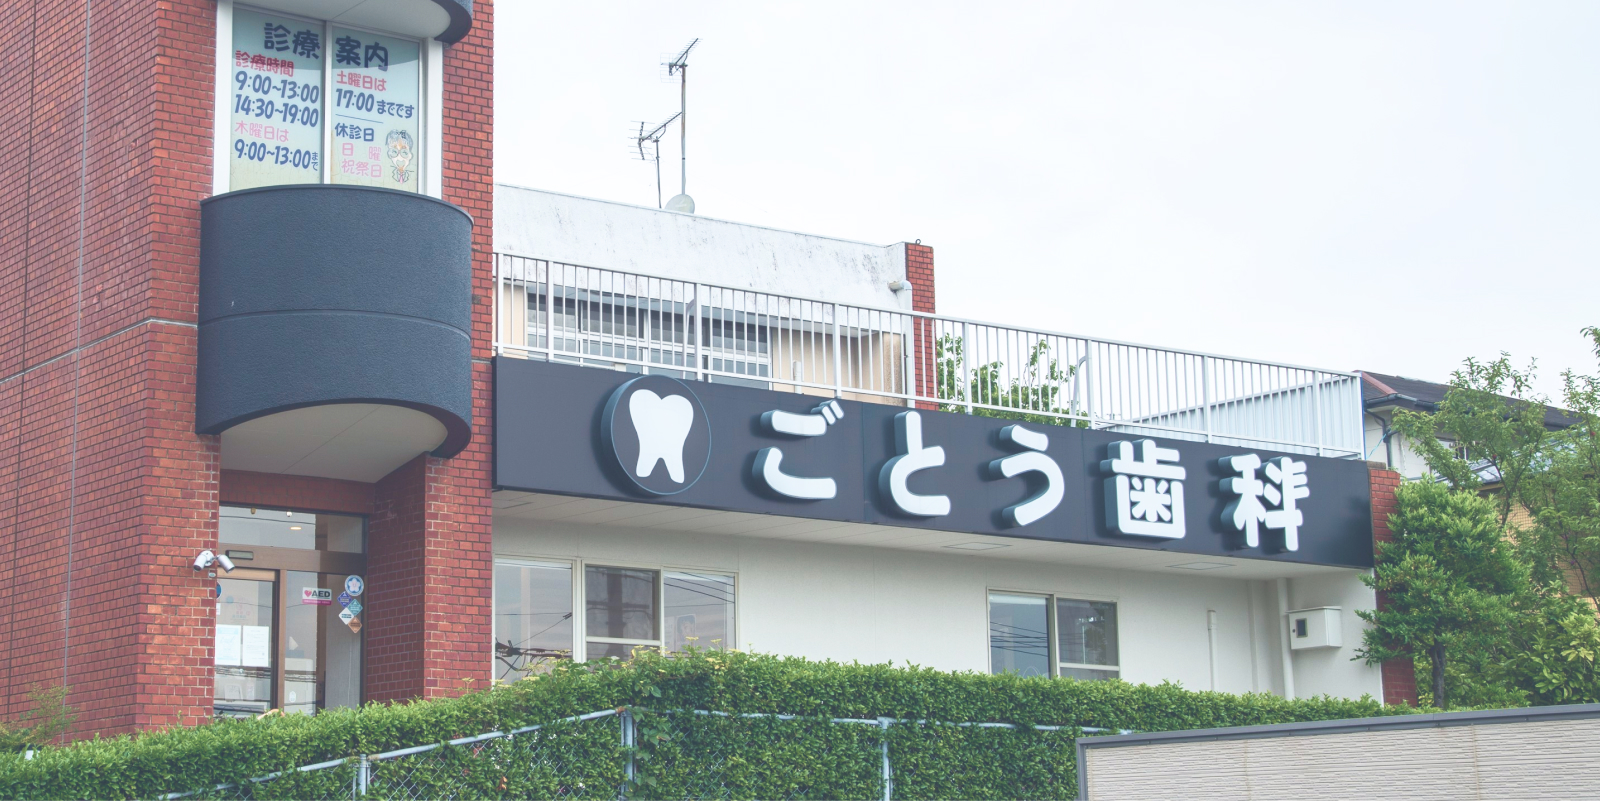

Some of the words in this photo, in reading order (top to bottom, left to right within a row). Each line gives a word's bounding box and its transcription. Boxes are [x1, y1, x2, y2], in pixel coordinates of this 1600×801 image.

[264, 22, 320, 60] 診療
[334, 35, 389, 72] 案内
[235, 50, 295, 77] 診療時間
[336, 70, 387, 92] 土曜日は
[234, 121, 290, 143] 木曜日は
[334, 122, 375, 142] 休診日
[341, 158, 382, 178] 祝祭日
[758, 400, 1310, 552] ごとう歯科
[311, 590, 331, 598] AED
